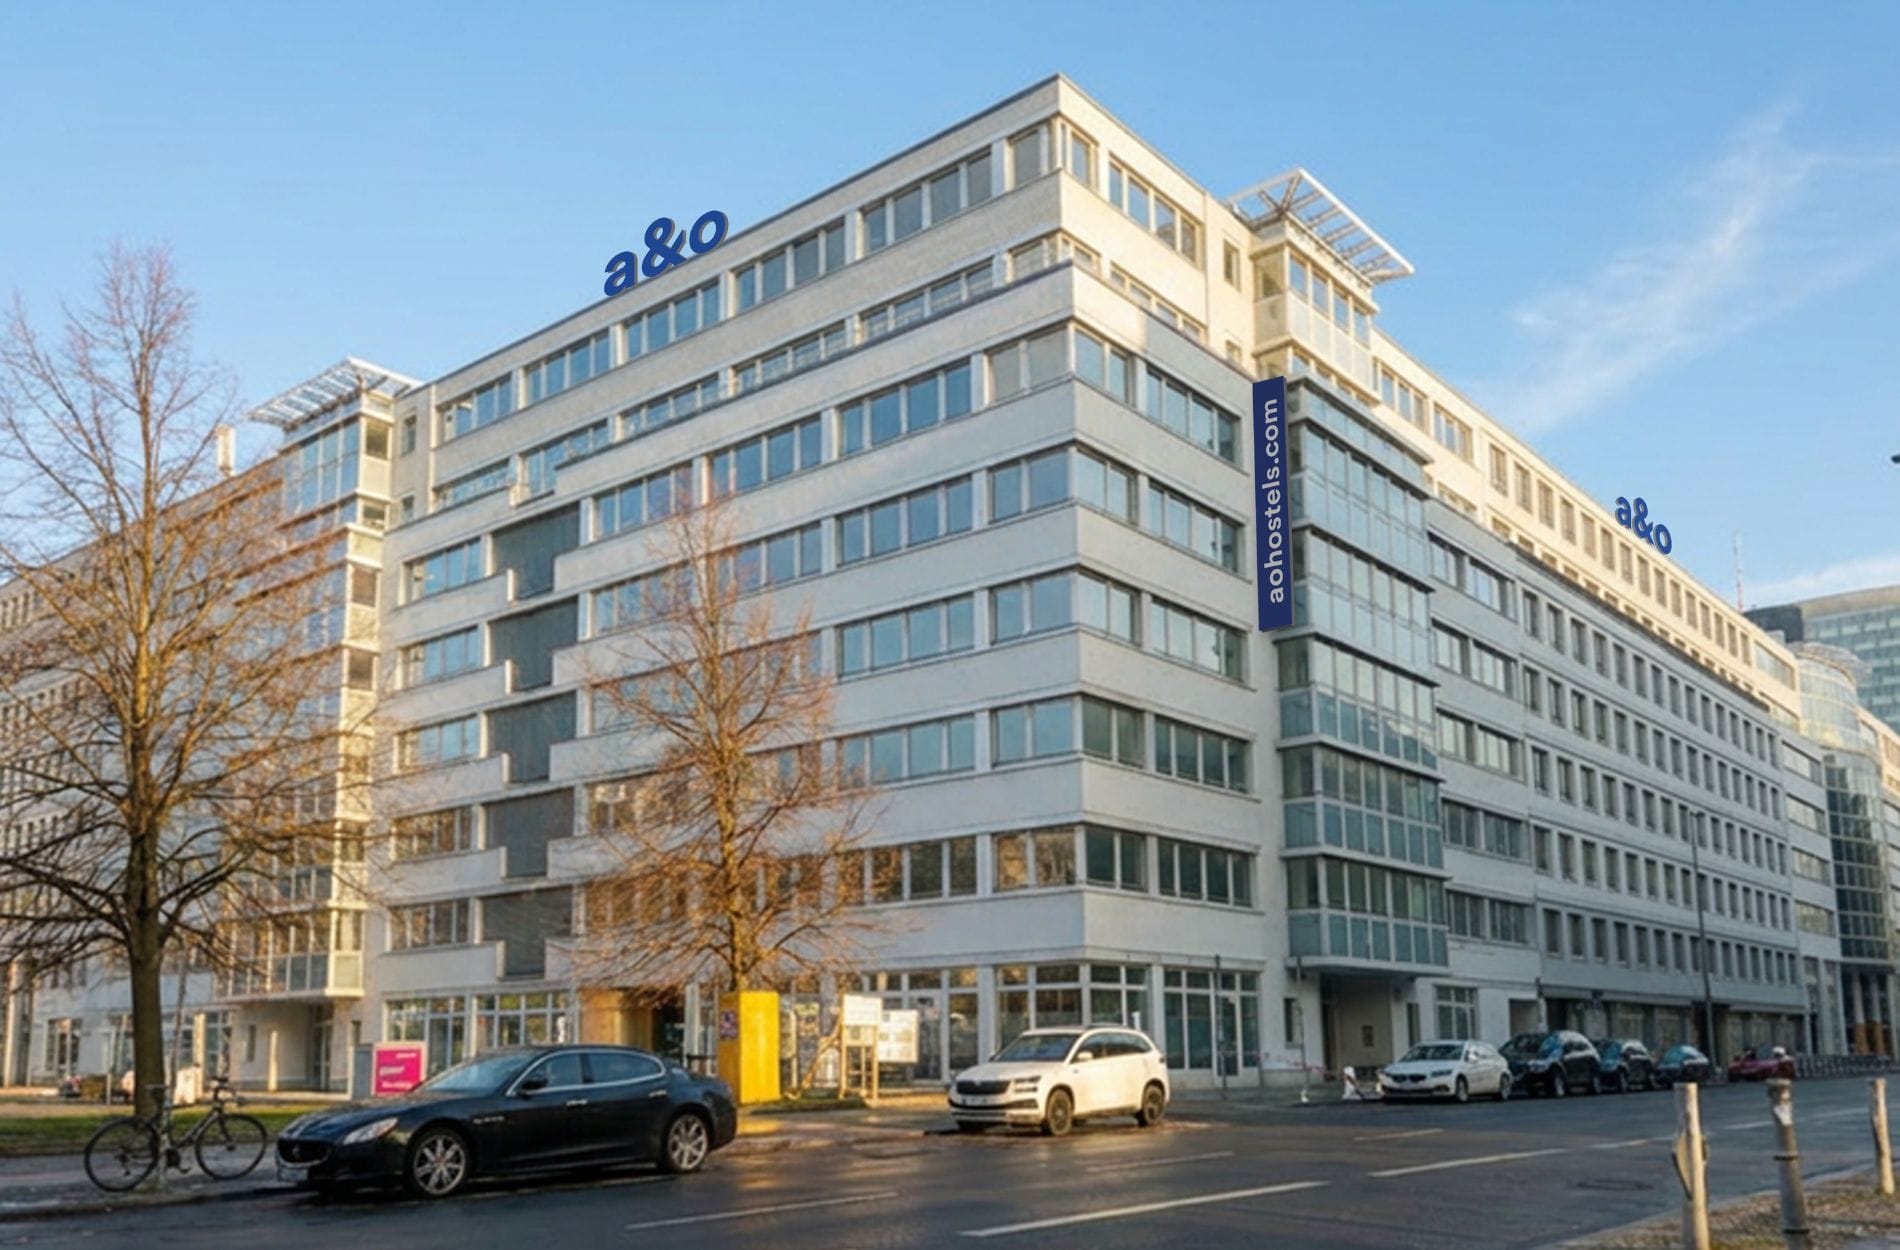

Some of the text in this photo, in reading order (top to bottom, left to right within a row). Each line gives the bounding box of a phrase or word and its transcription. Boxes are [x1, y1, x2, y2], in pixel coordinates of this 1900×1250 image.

[604, 210, 728, 296] a&o
[1261, 398, 1285, 604] aohostels.com
[1615, 496, 1672, 555] a&o
